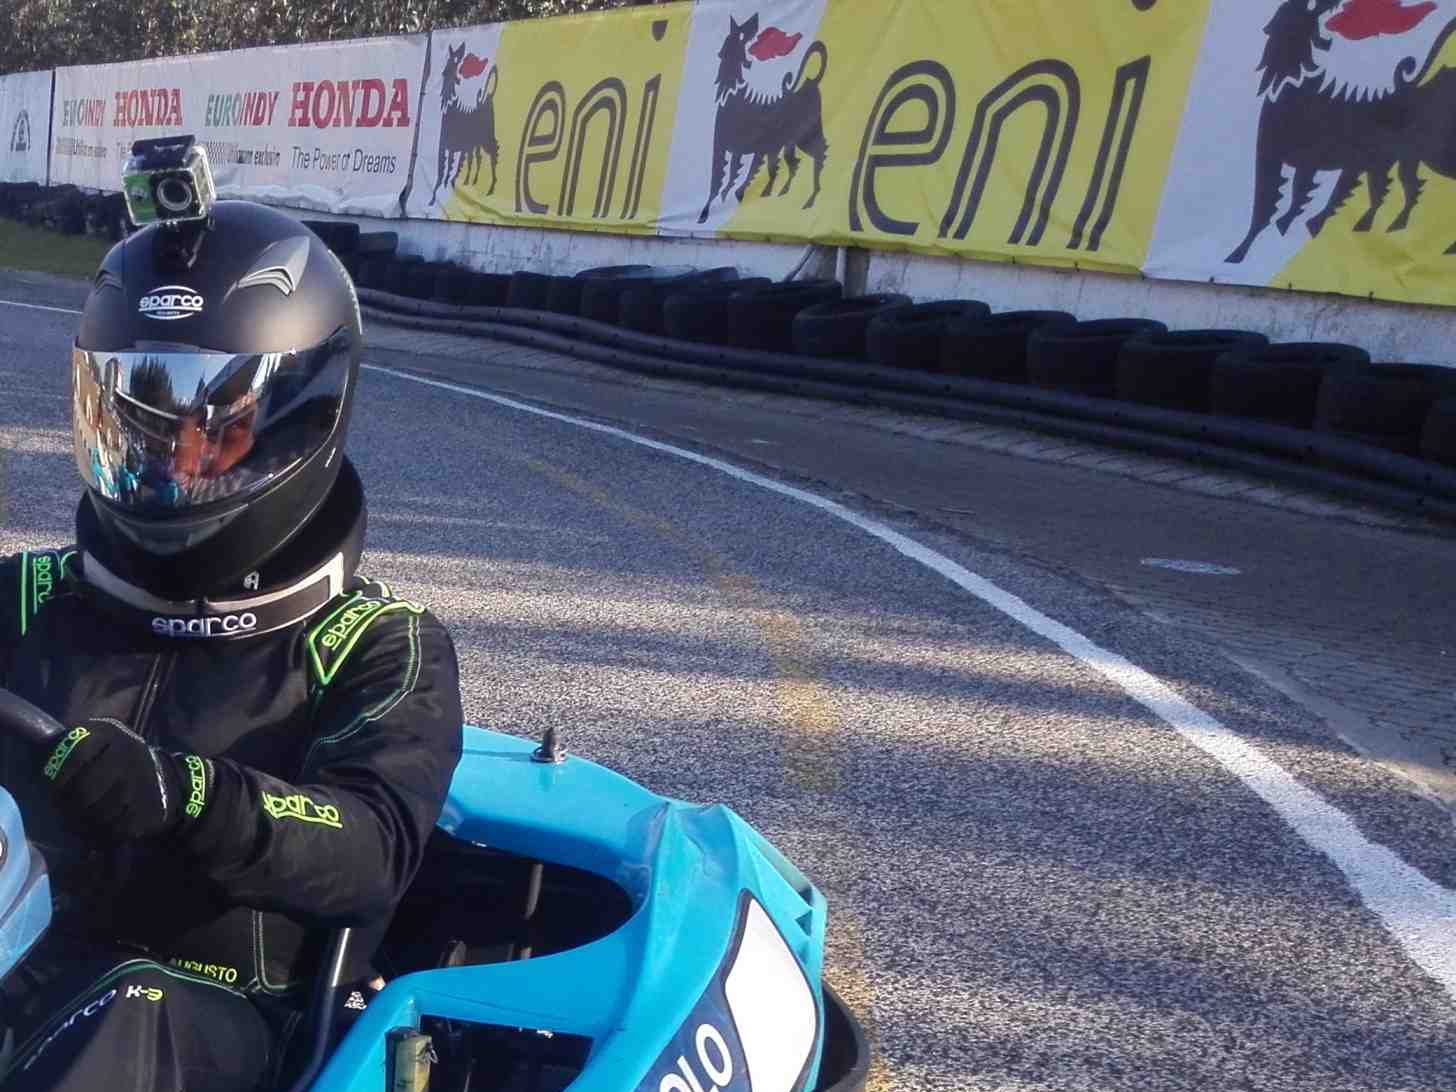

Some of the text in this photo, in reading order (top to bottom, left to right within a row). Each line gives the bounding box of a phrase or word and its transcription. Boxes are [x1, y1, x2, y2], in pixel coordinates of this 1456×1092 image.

[113, 88, 183, 127] HONDA
[204, 78, 410, 129] EUROINDY HONDA
[514, 20, 669, 219] eni
[848, 0, 1154, 252] eni
[293, 146, 310, 169] The
[313, 147, 340, 171] Power
[353, 148, 396, 174] Dreams
[139, 295, 204, 311] sparco
[33, 555, 53, 607] sparc
[151, 612, 257, 638] sparco
